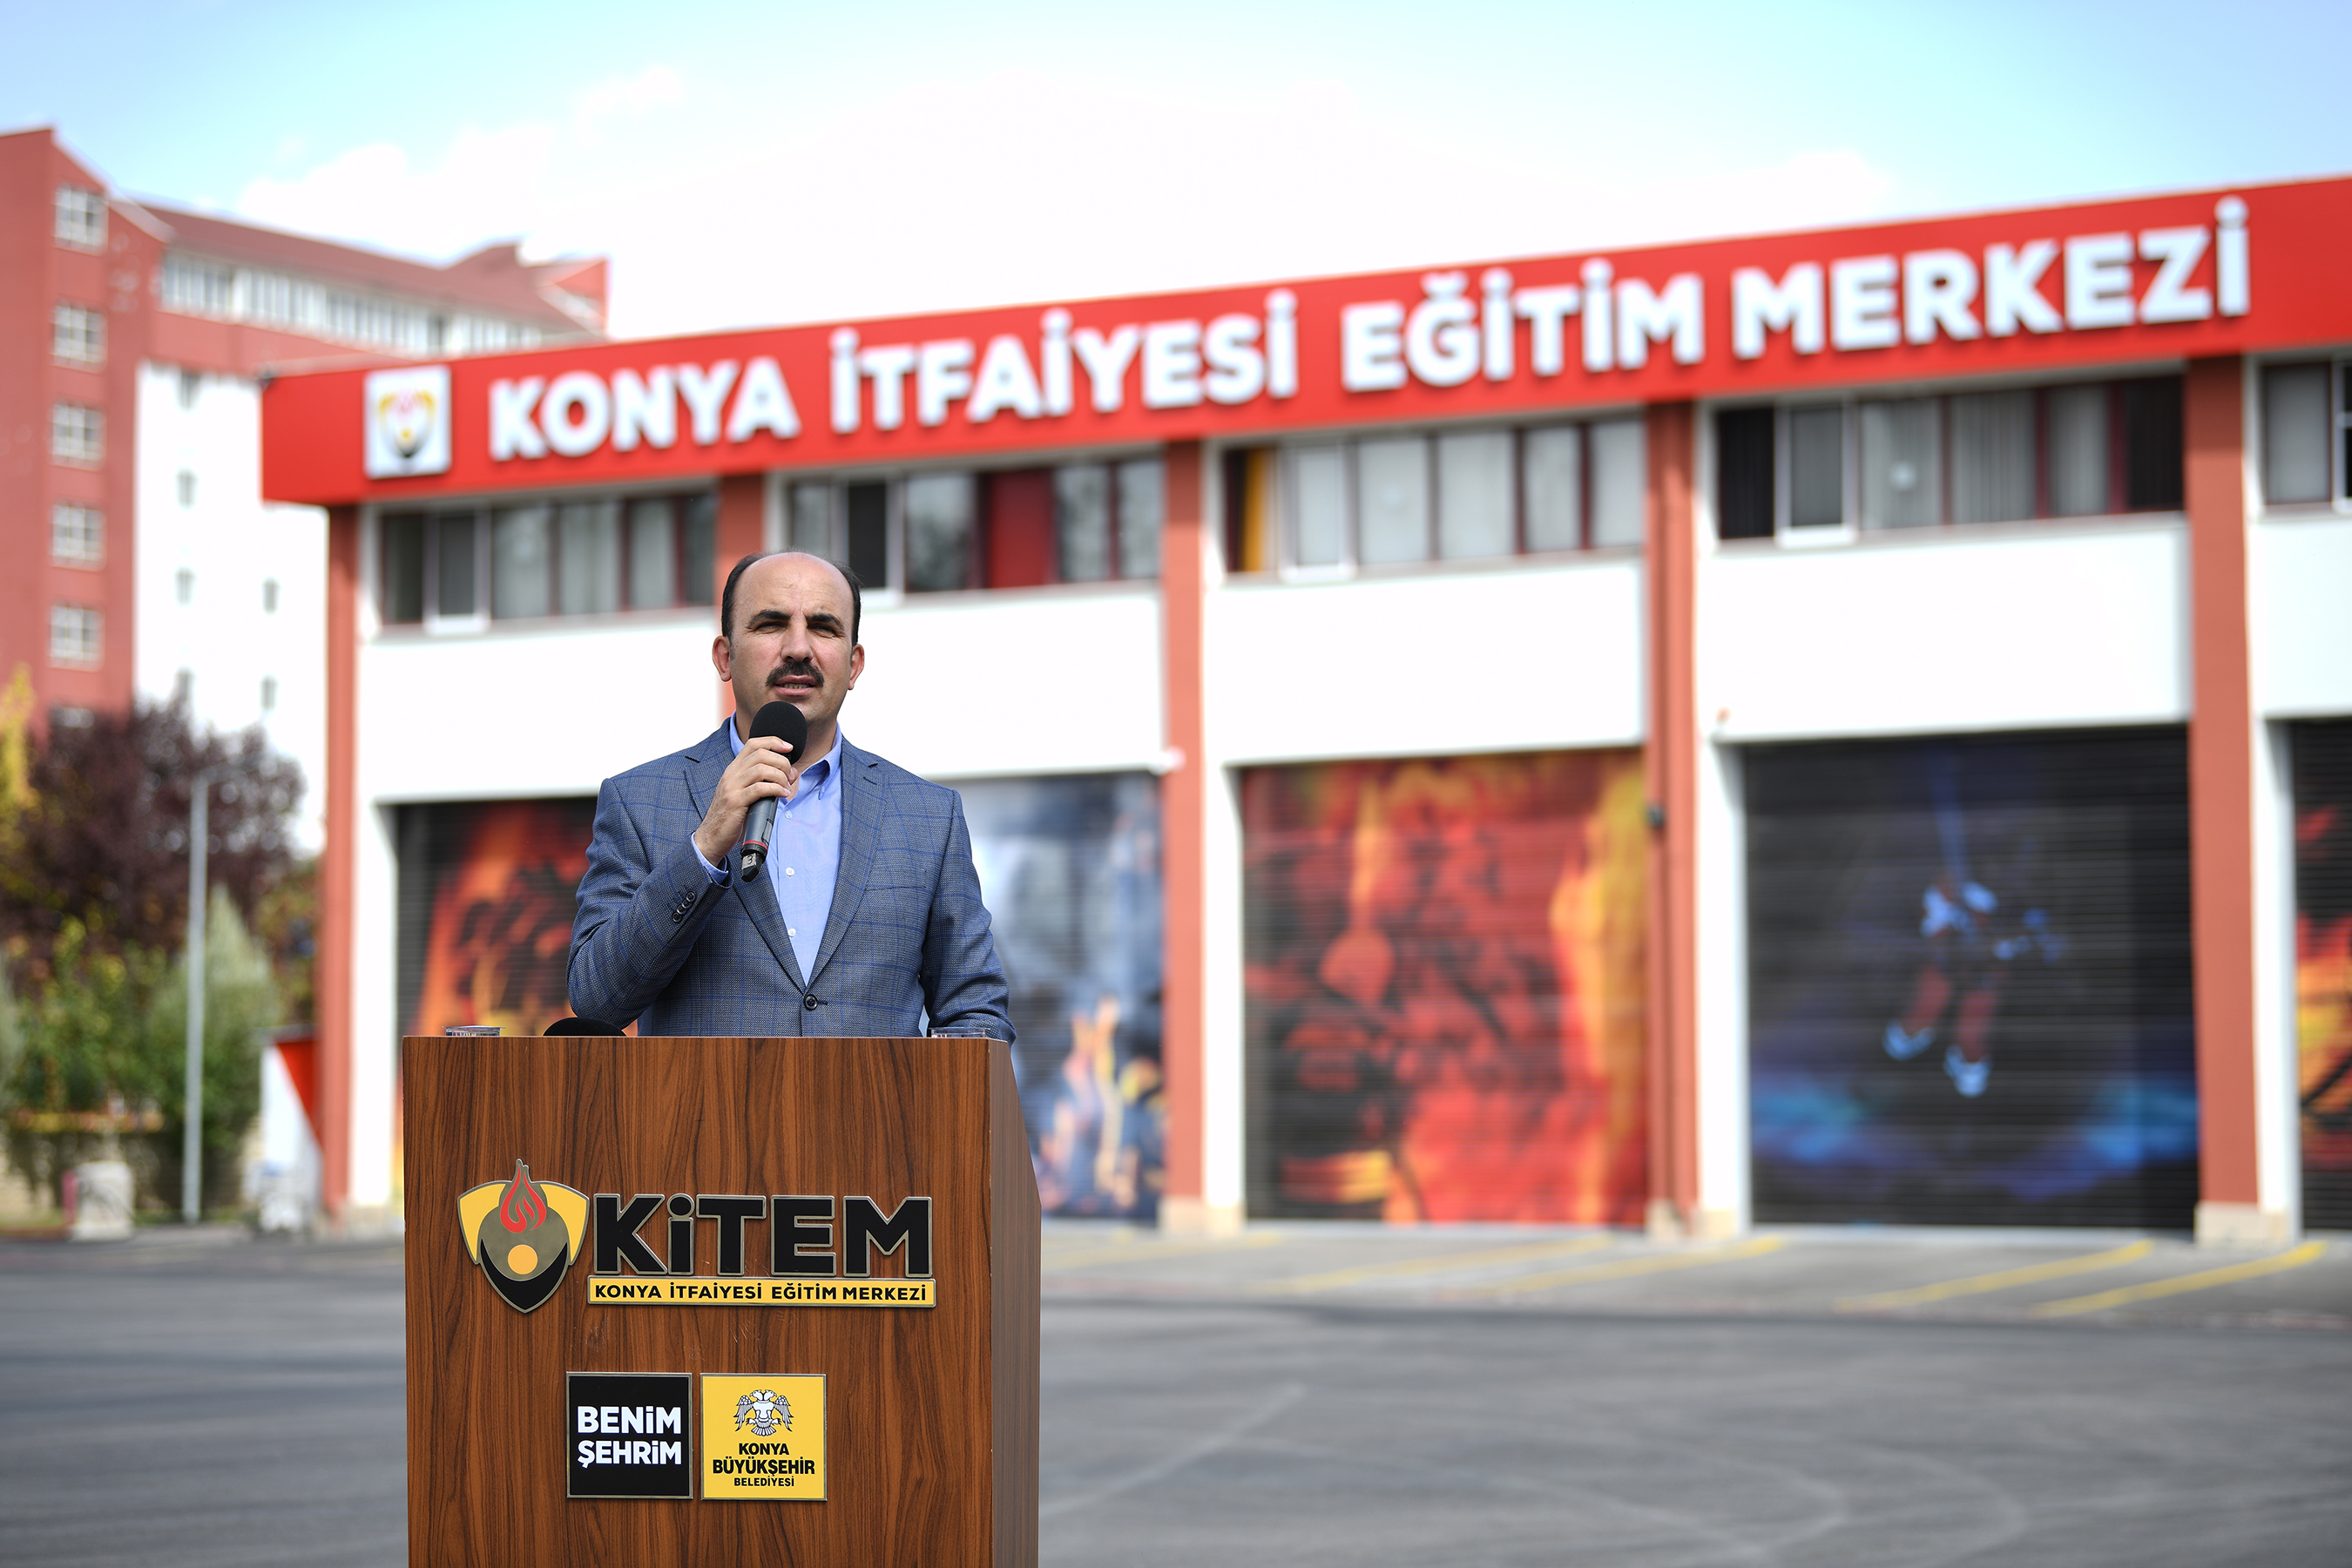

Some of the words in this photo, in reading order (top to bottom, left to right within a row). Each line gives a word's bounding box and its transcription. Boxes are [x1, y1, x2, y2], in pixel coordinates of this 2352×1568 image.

[489, 356, 801, 462] KONYA
[829, 288, 1298, 435] İTFAİYESİ
[1341, 256, 1705, 391] EĞİTİM
[1731, 195, 2250, 361] MERKEZİ
[595, 1284, 662, 1299] KONYA
[670, 1281, 762, 1300] İTFAİYESİ
[771, 1282, 837, 1300] EĞİTİM
[842, 1284, 926, 1301] MERKEZİ
[739, 1443, 790, 1456] KONYA
[713, 1456, 815, 1477] BÜYÜKŞEHİR
[733, 1476, 794, 1487] BELEDİYESİ
